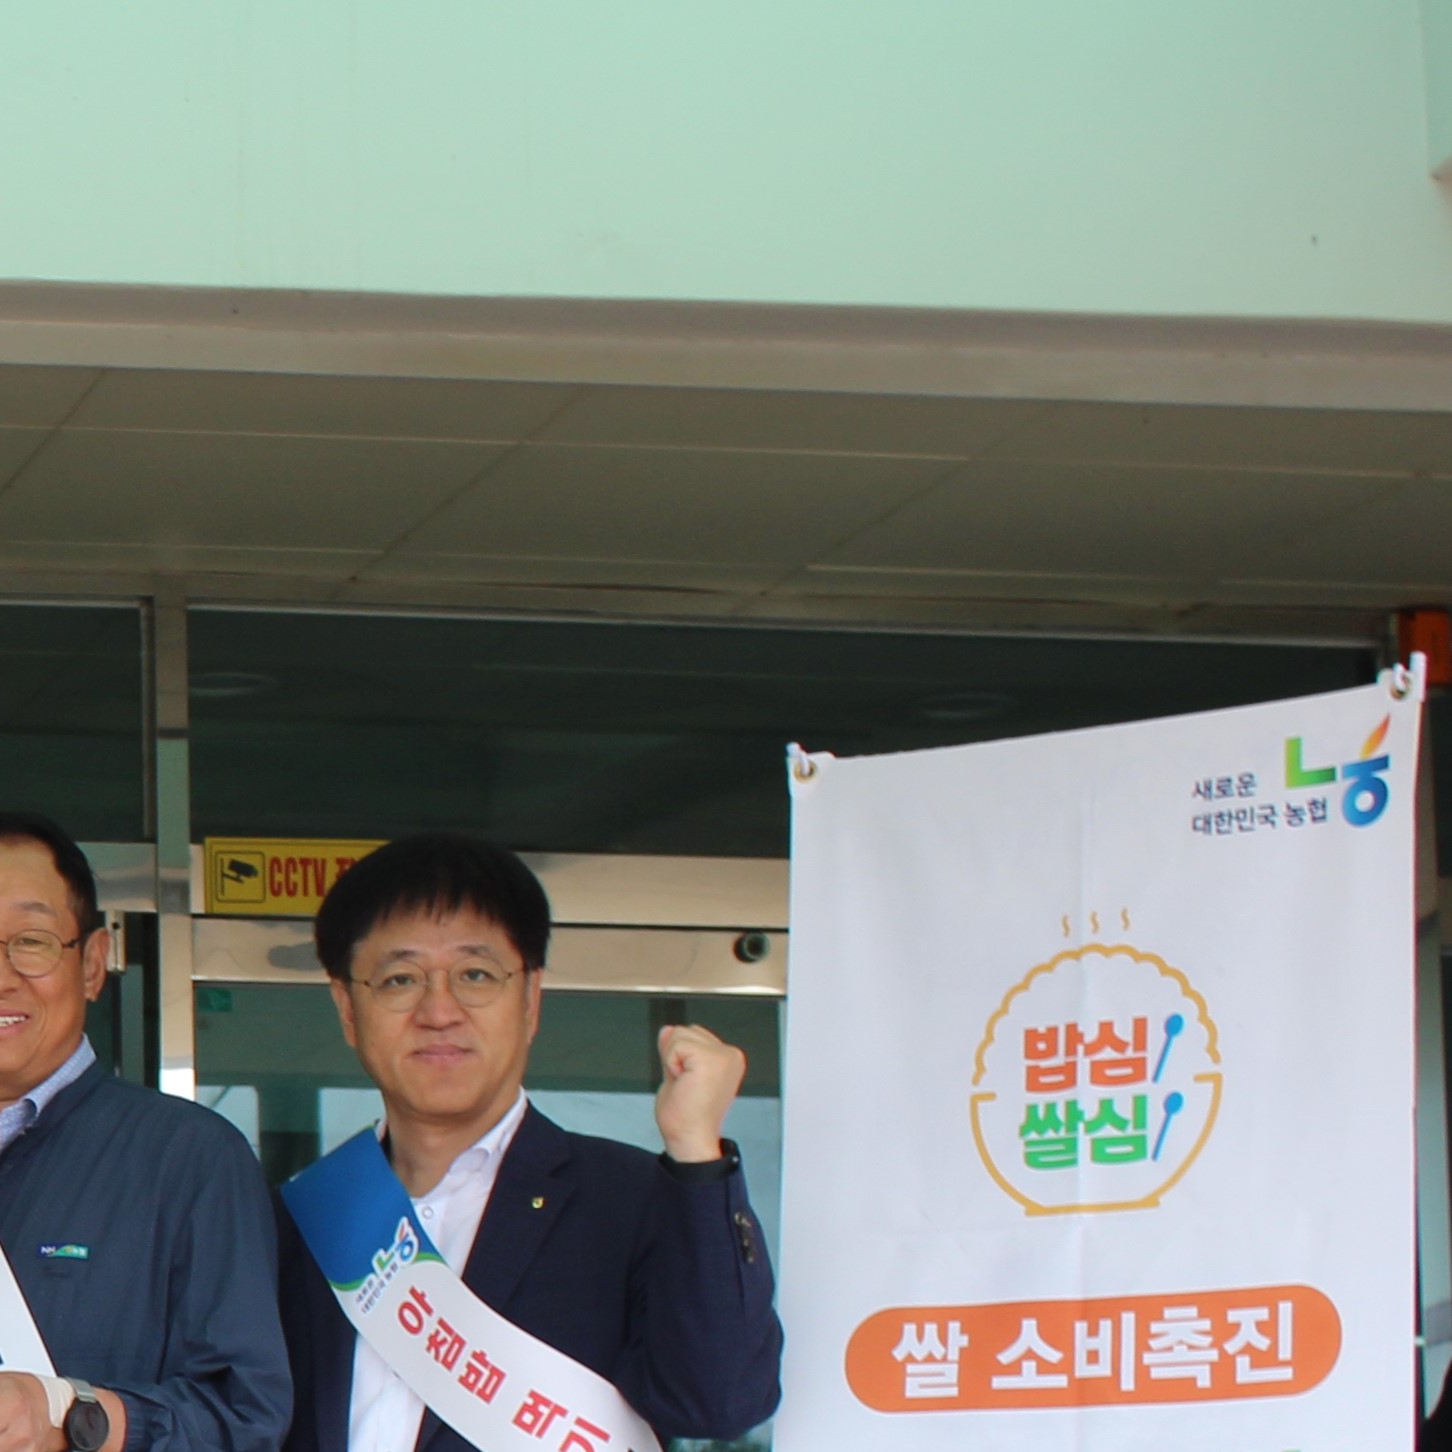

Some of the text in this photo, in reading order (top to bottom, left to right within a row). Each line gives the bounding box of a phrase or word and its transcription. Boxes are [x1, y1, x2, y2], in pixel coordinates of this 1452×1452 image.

[1192, 798, 1328, 835] 대한민국 농협
[1193, 771, 1257, 801] 새로운
[269, 856, 327, 897] CCTV
[1023, 1016, 1149, 1093] 밥심
[1019, 1095, 1149, 1171] 쌀심
[397, 1285, 507, 1405] 아침밥
[891, 1300, 1296, 1399] 쌀 소비촉진
